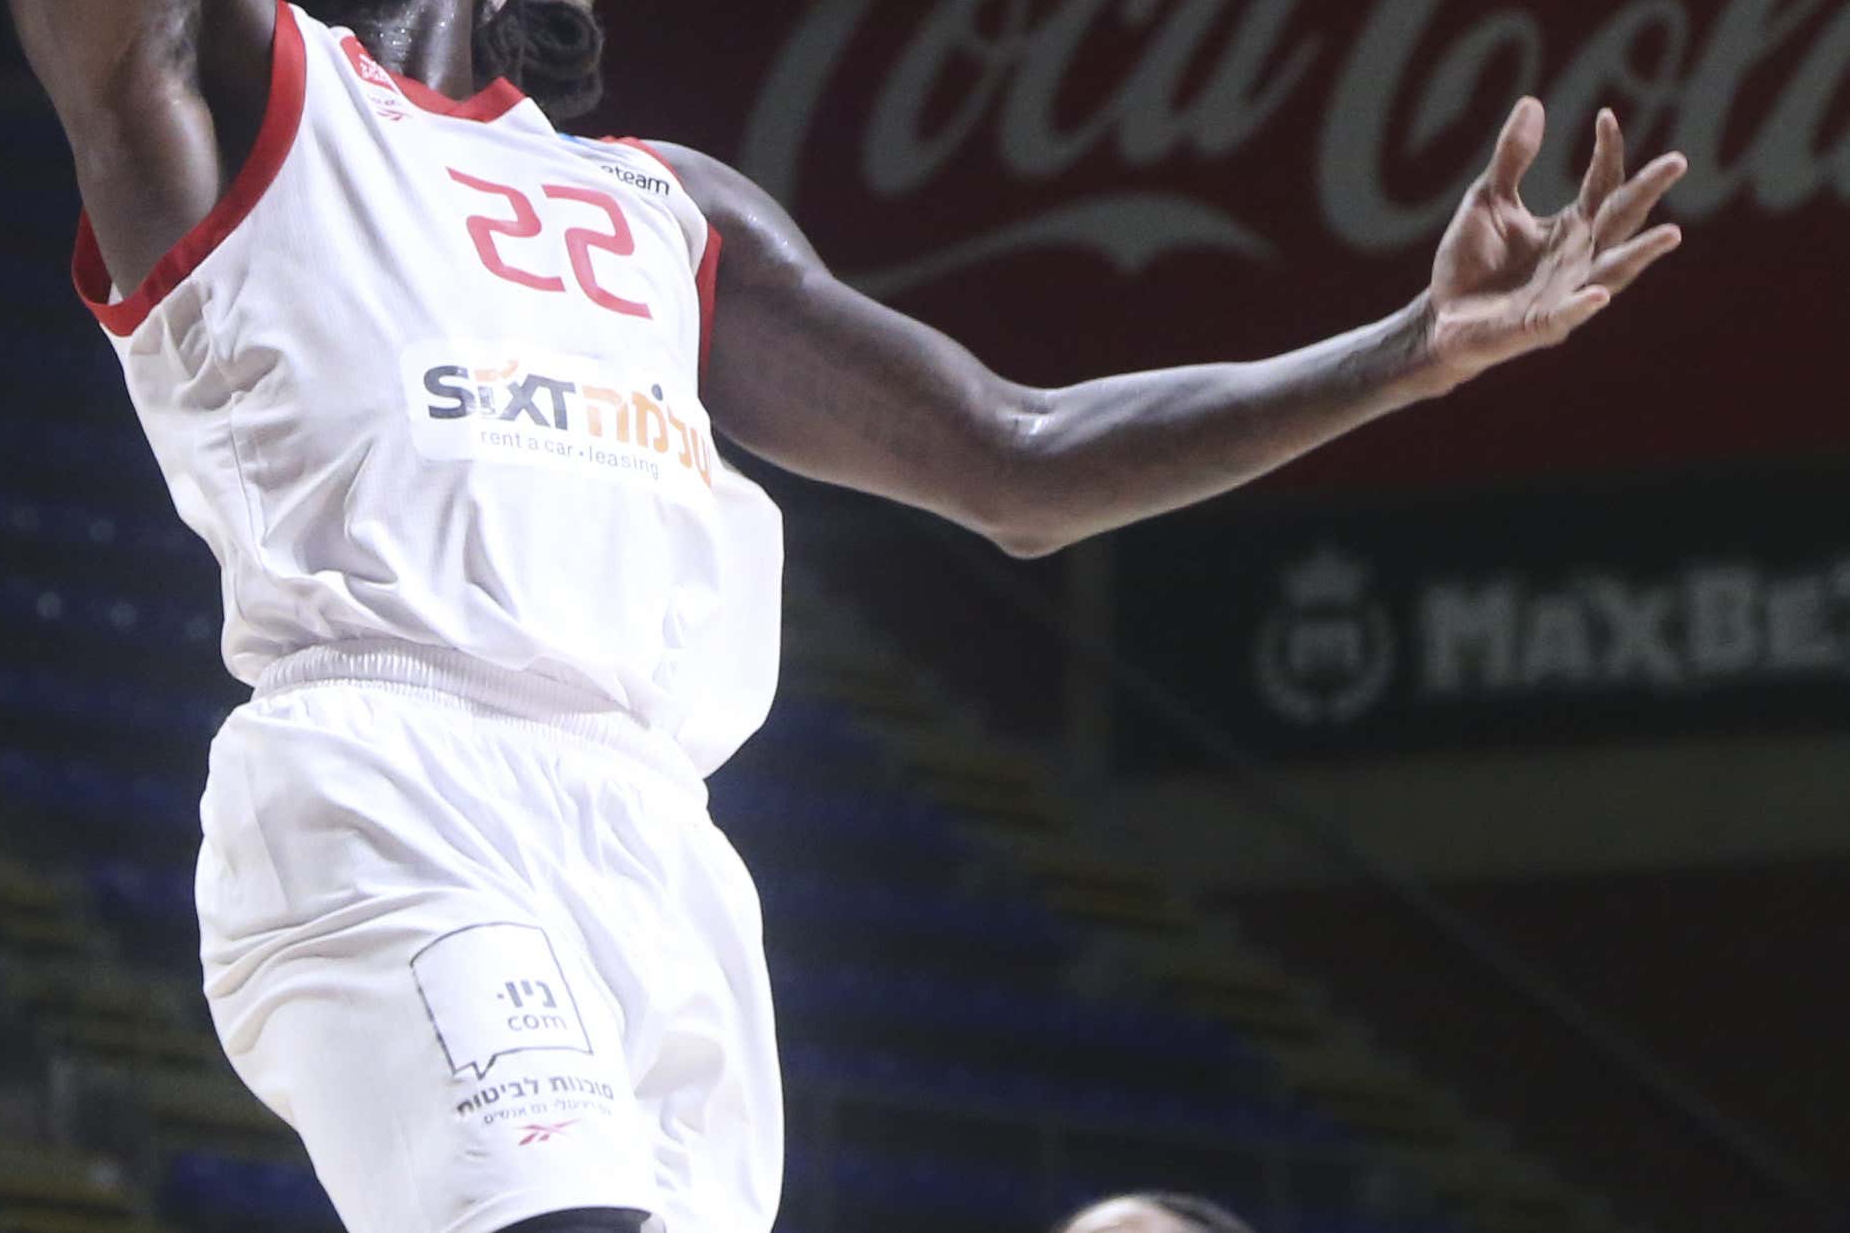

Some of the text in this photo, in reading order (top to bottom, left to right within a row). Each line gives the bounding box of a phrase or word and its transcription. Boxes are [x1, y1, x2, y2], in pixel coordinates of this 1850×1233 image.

[445, 166, 654, 319] 22
[480, 429, 659, 480] rent a car leasing
[507, 1013, 567, 1031] com
